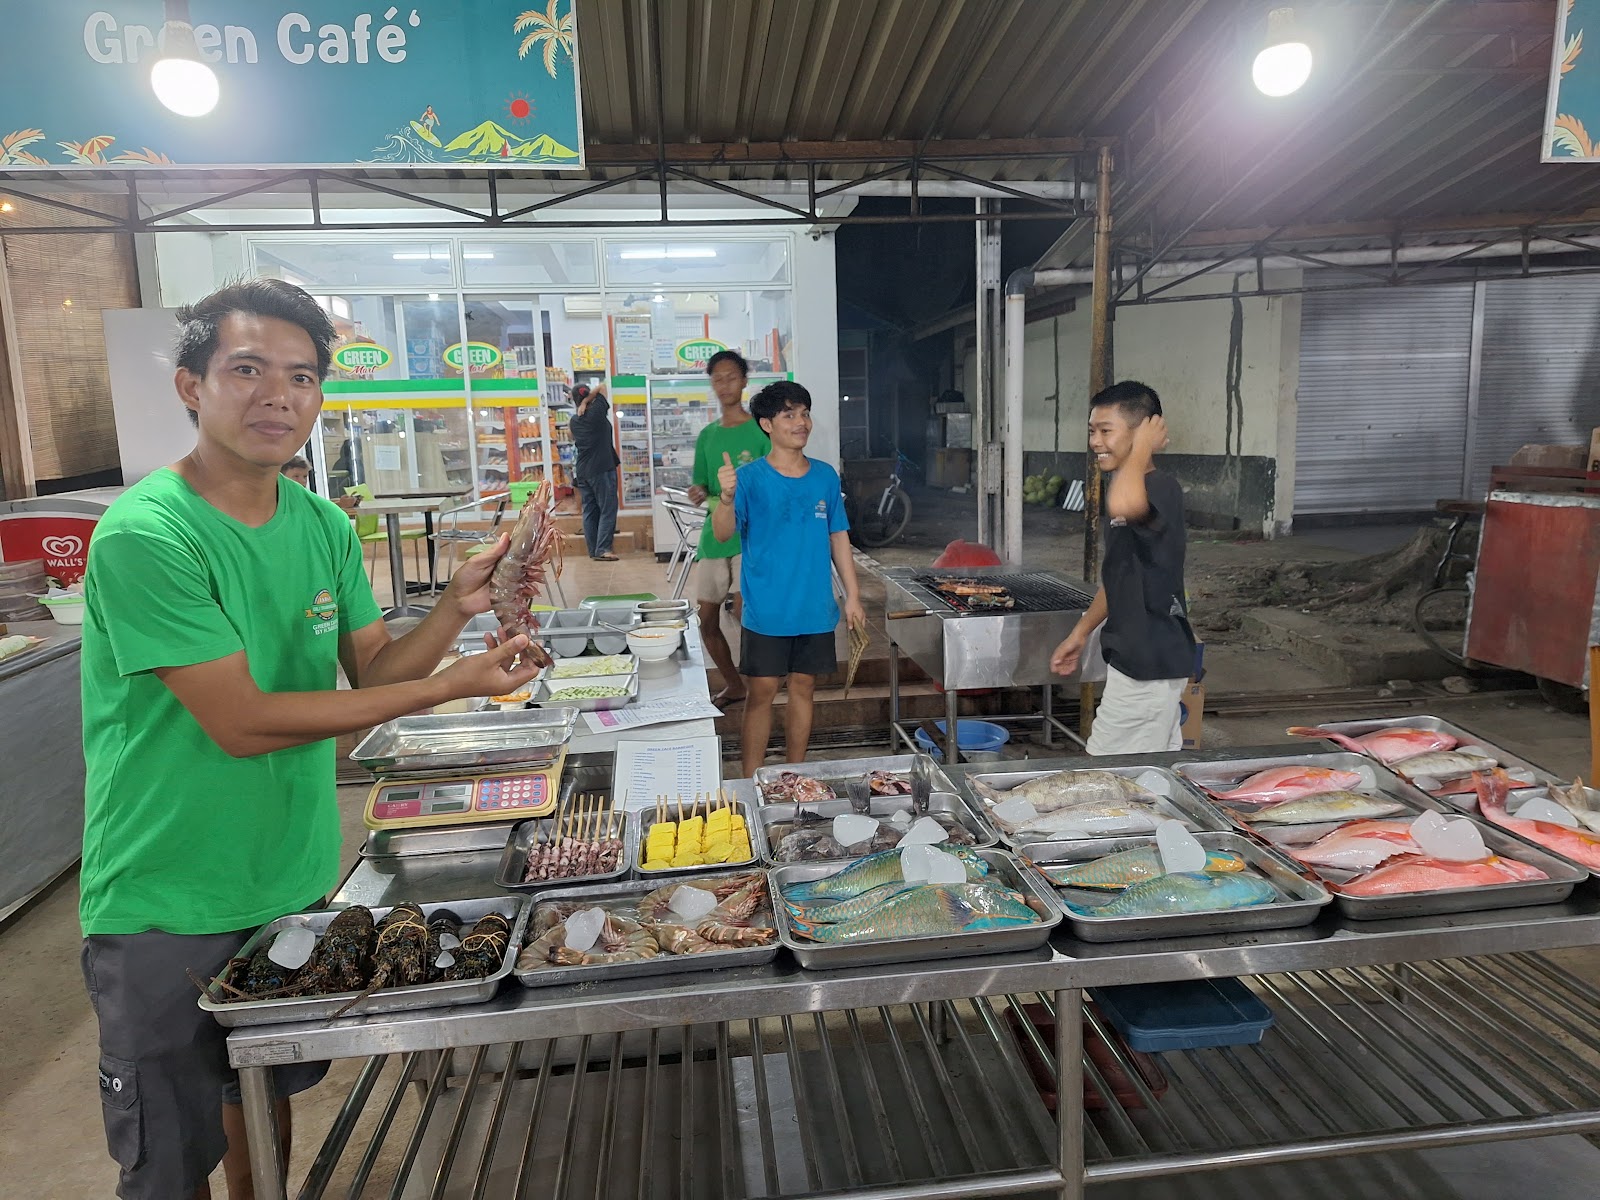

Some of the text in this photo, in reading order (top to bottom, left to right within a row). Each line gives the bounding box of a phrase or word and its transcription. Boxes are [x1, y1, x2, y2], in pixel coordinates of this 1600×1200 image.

[84, 11, 258, 64] Gren
[343, 350, 382, 365] GREEN
[453, 349, 492, 363] GEEN
[348, 365, 377, 375] Mart
[46, 558, 83, 567] WALL'S
